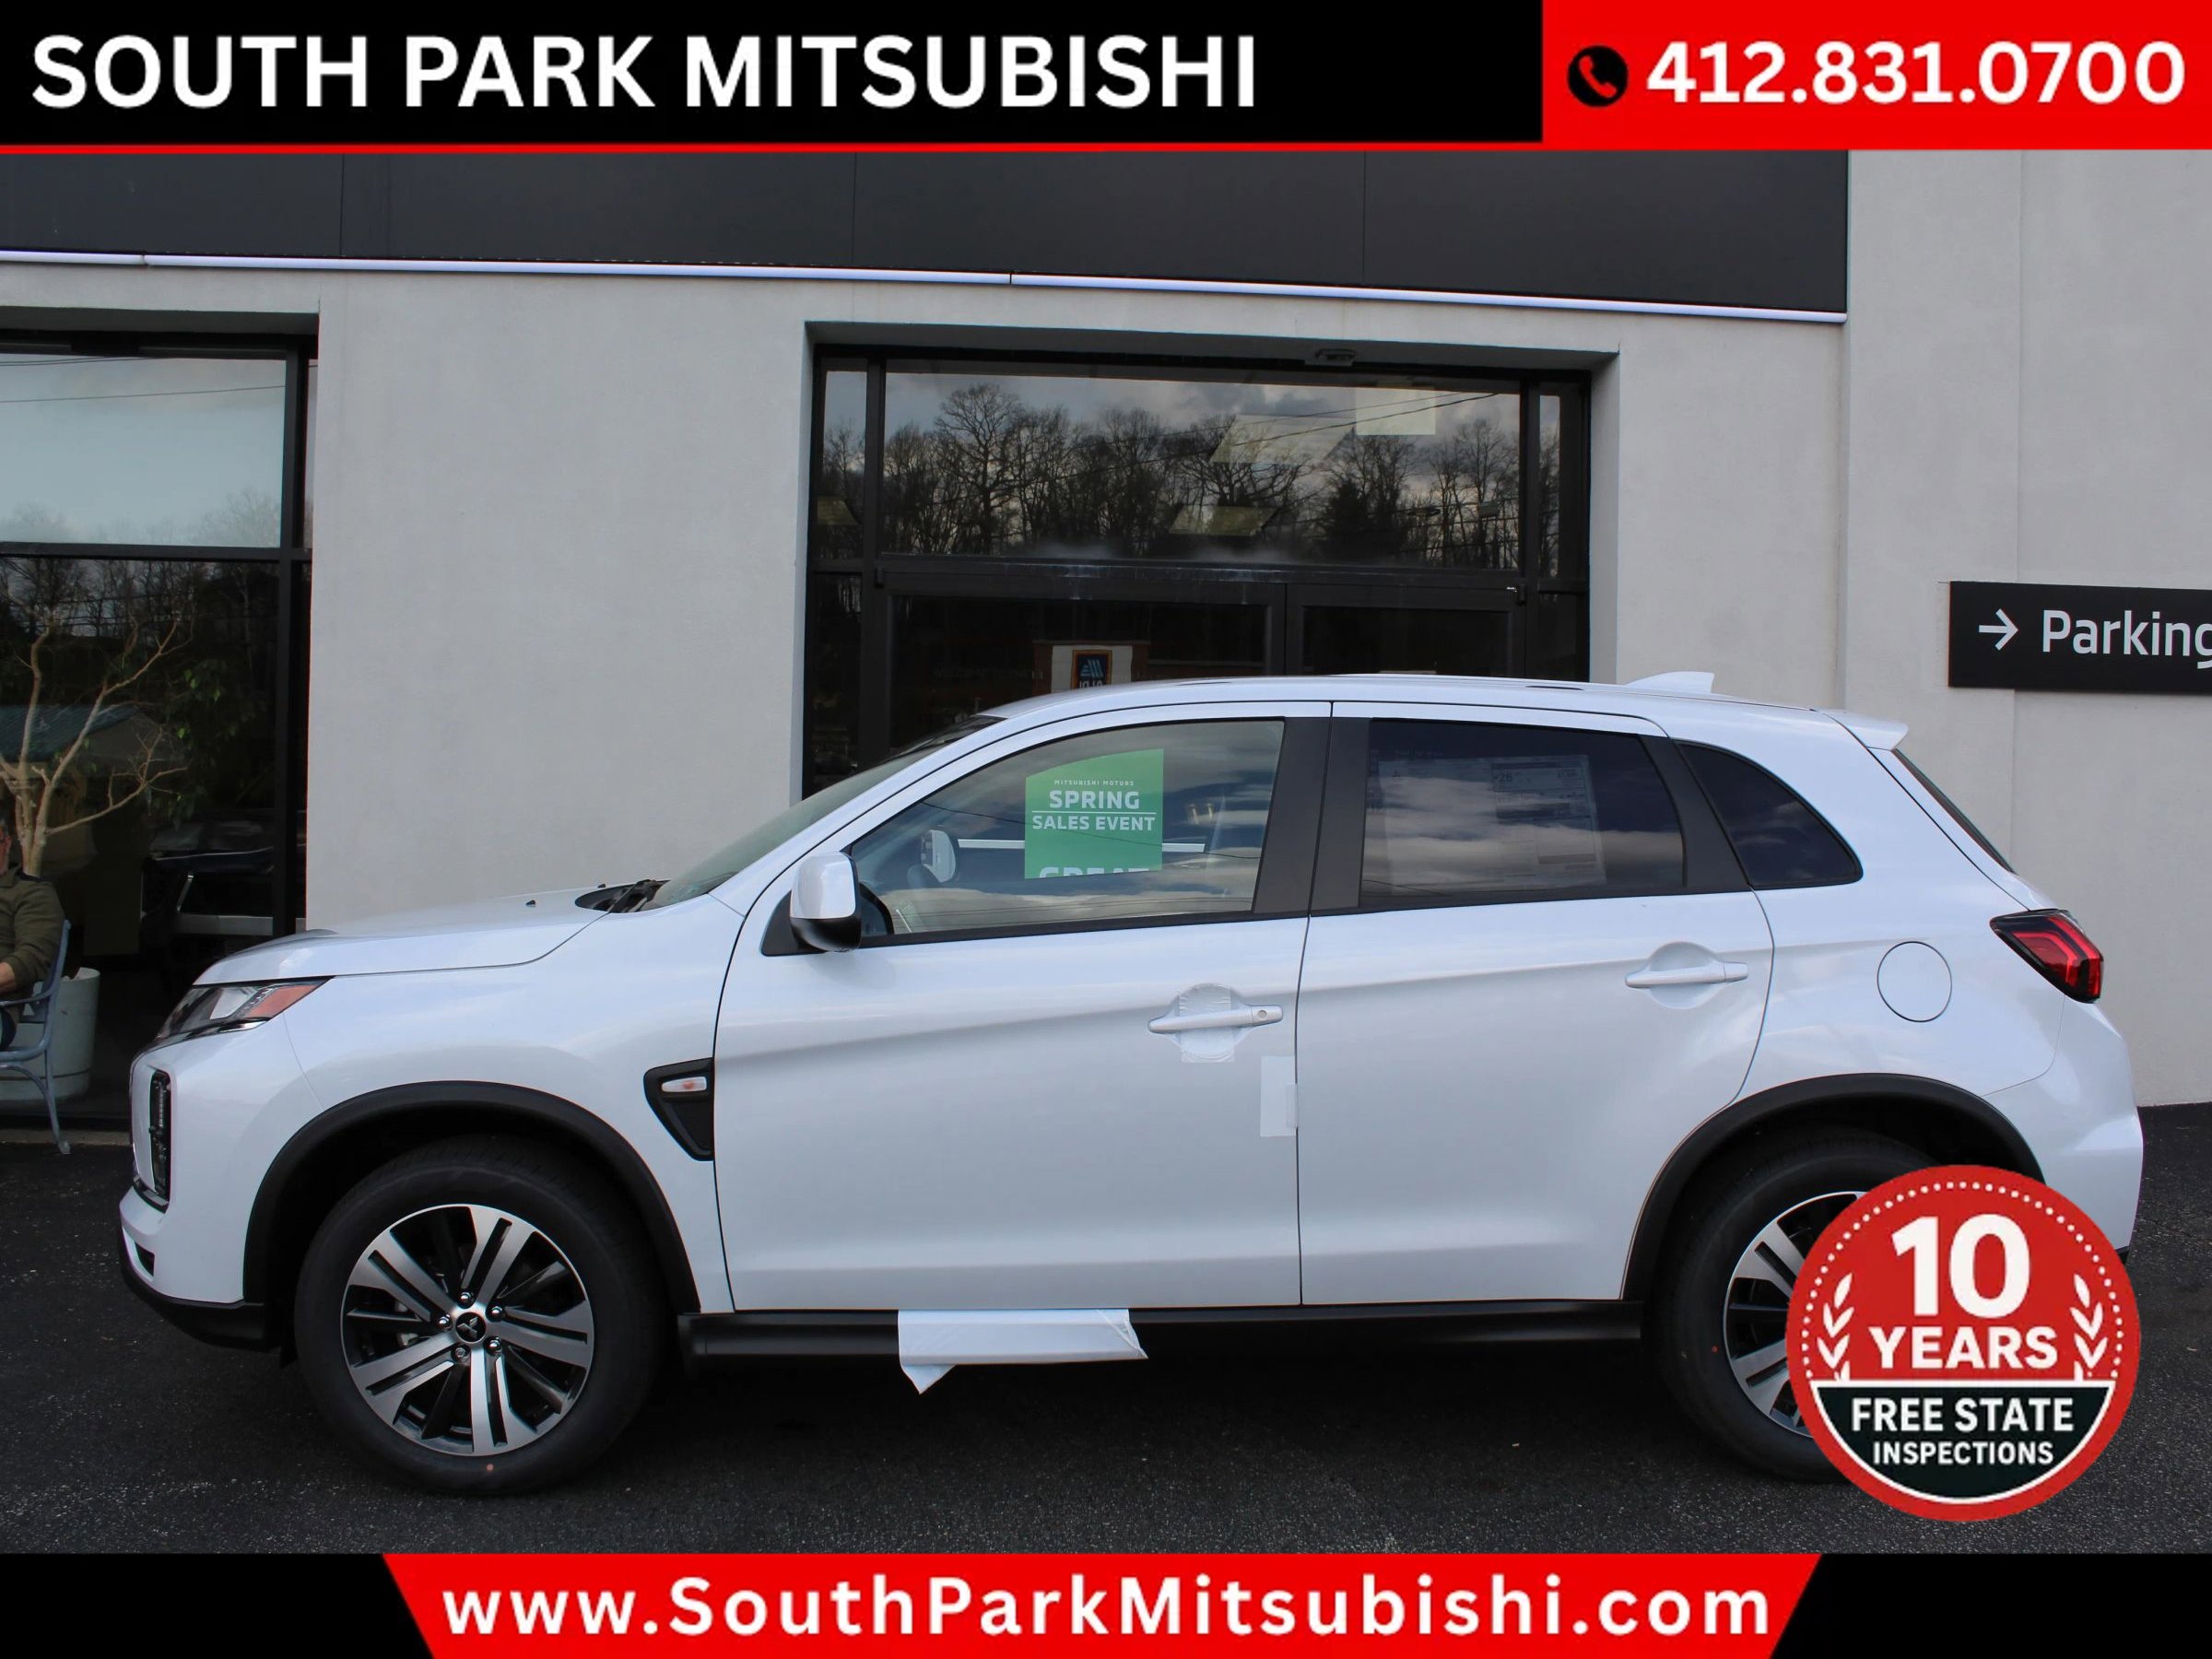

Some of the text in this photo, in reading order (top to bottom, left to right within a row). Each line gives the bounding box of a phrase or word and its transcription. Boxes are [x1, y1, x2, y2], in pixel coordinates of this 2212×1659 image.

[2042, 609, 2212, 669] Parking
[1049, 790, 1140, 809] SPRING
[1032, 815, 1156, 830] SALES EVENT
